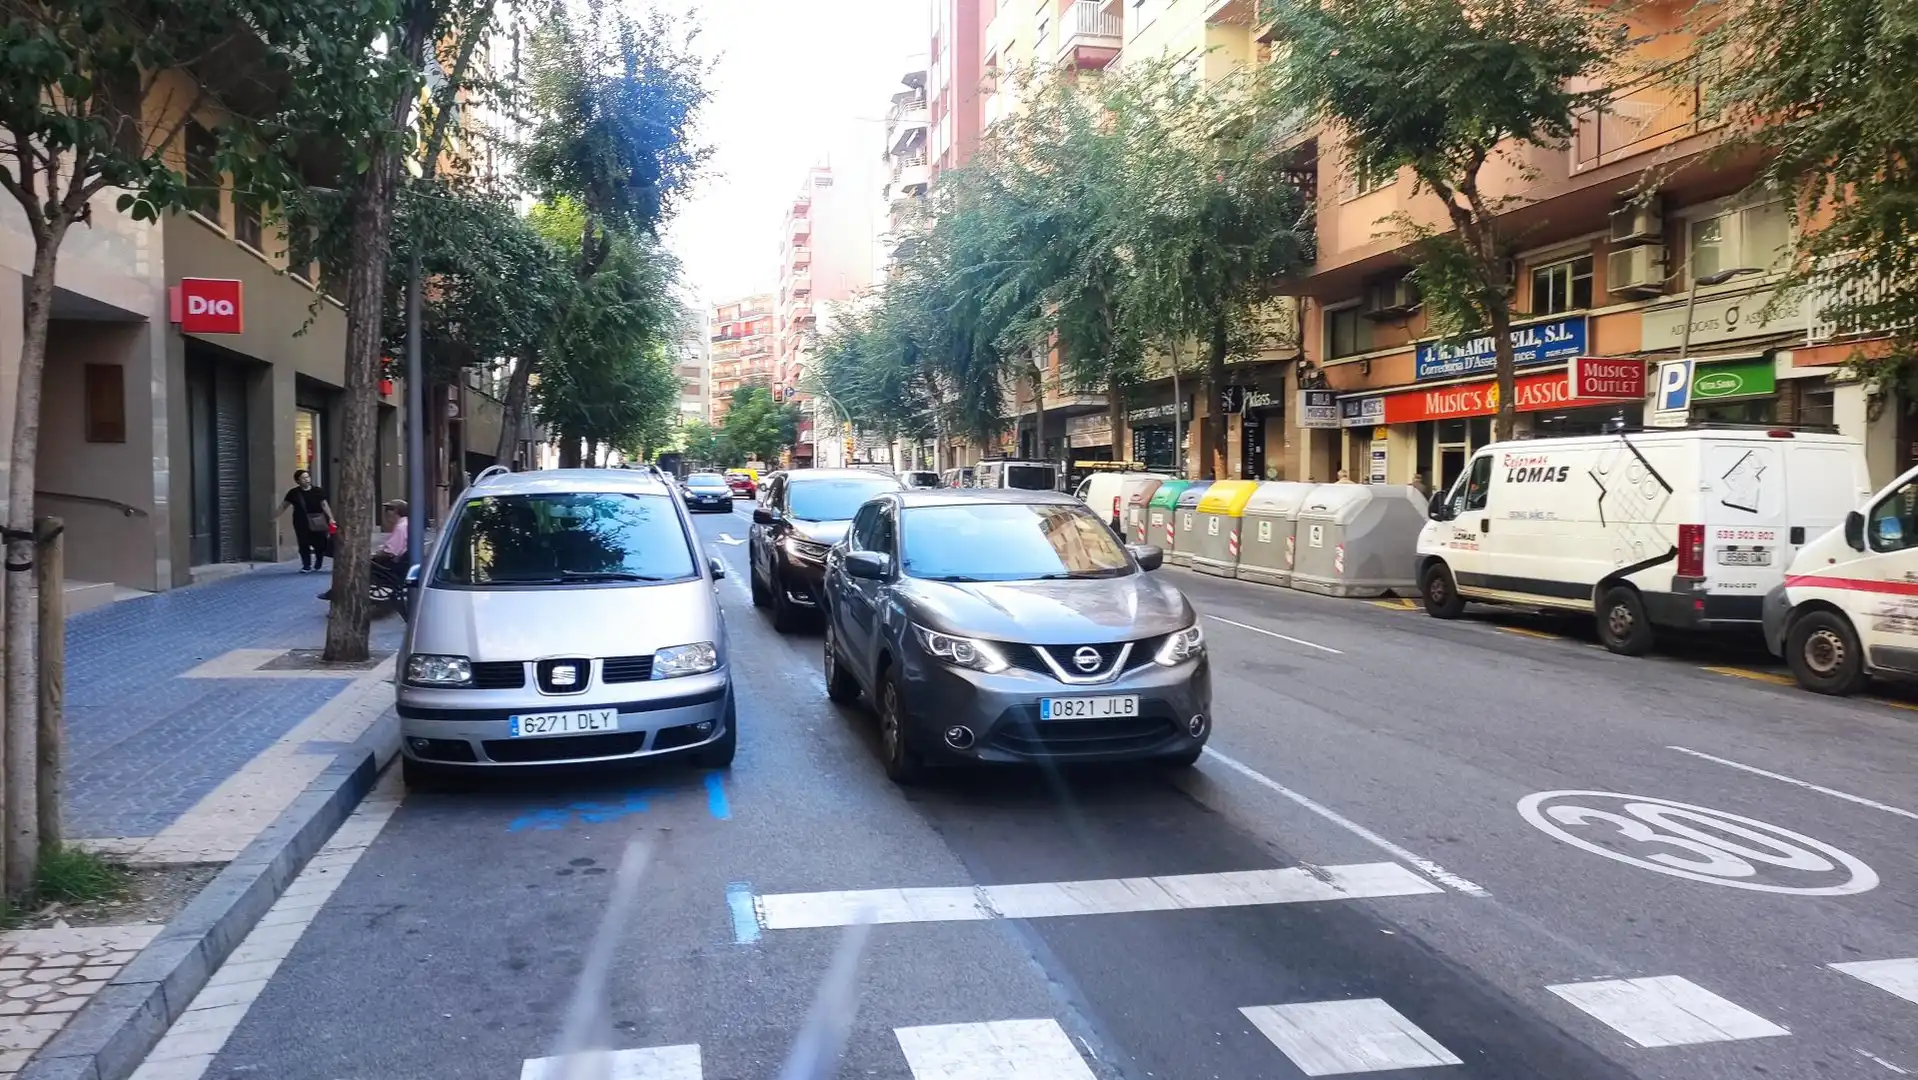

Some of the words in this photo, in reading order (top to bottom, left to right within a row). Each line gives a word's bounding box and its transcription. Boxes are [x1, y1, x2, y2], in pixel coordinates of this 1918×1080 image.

[1584, 363, 1640, 378] MUSIC'S
[1585, 378, 1638, 393] OUTLET
[1659, 363, 1686, 410] P
[1425, 390, 1482, 415] MUSIC'S
[1514, 381, 1570, 405] LASSIC
[1506, 466, 1570, 483] LOMAS
[1053, 700, 1094, 716] 0821
[1103, 699, 1134, 715] JLB
[524, 715, 568, 733] 6271
[578, 712, 610, 729] DLY
[1546, 803, 1835, 877] 30
